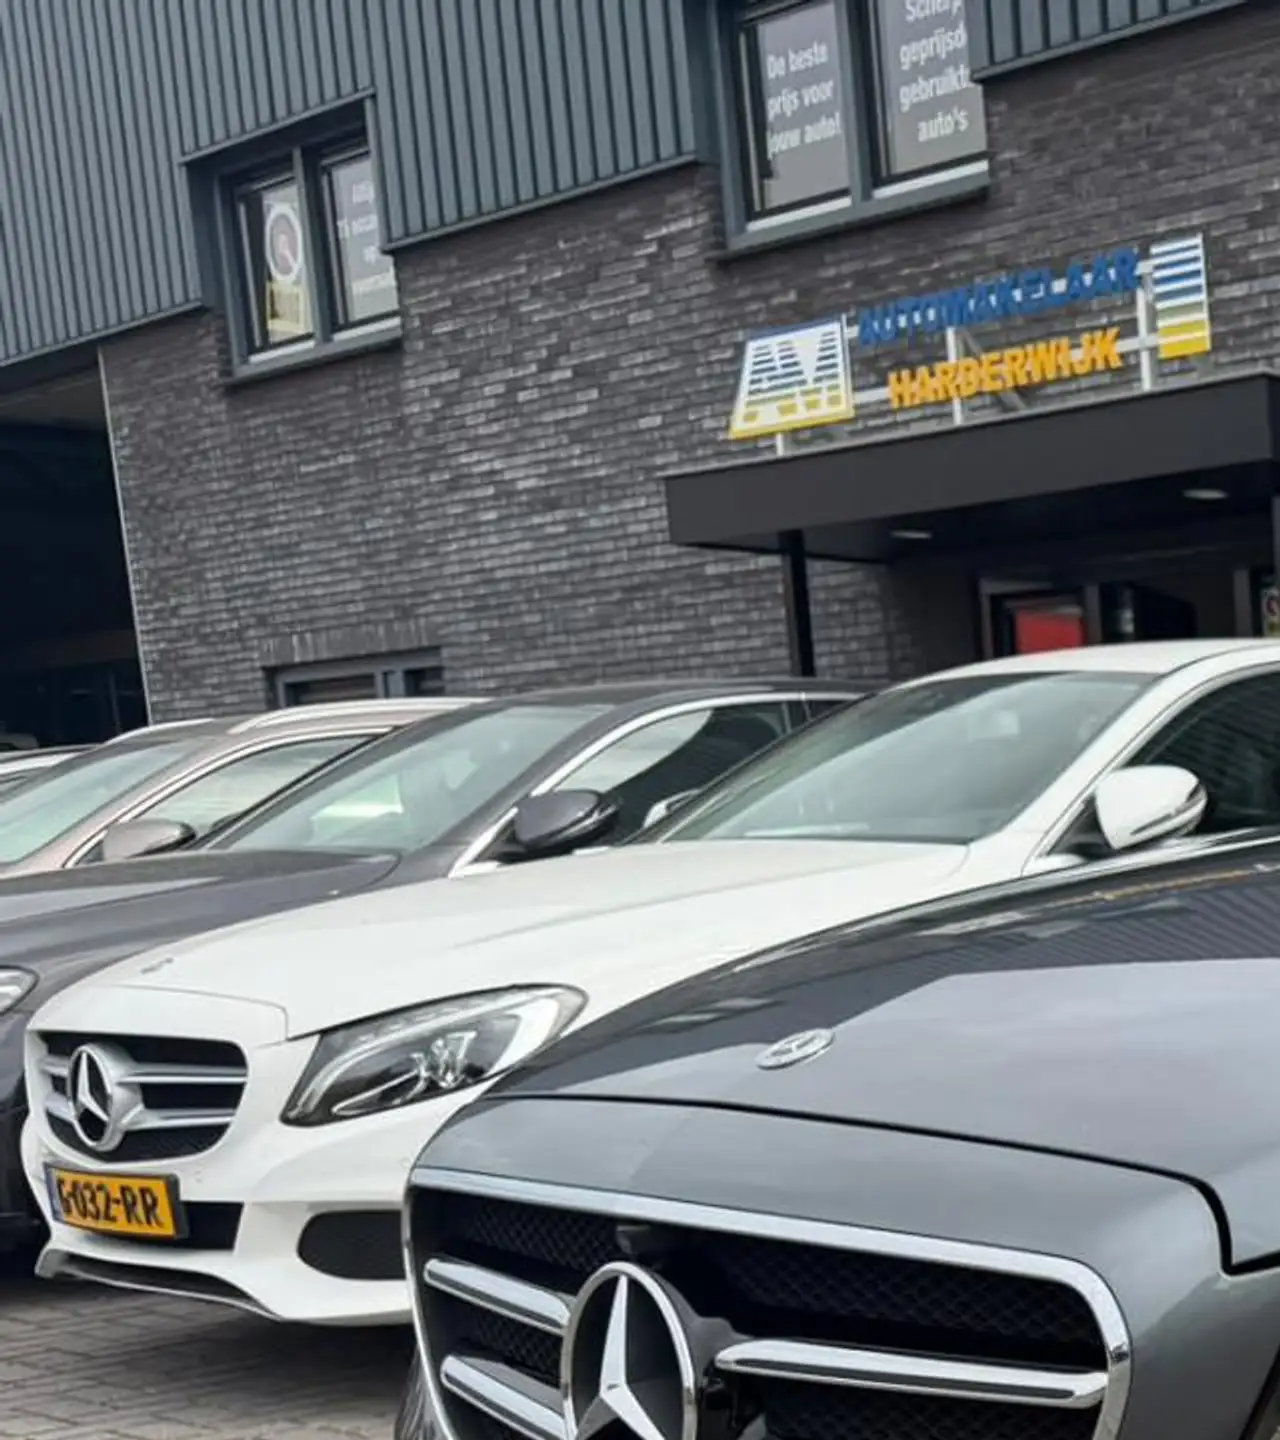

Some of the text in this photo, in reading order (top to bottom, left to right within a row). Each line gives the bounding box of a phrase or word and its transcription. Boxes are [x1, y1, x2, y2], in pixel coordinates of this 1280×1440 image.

[766, 40, 829, 80] De beste
[899, 21, 968, 71] geprijsd
[767, 80, 834, 122] prijs voor
[804, 112, 842, 144] auto!
[918, 106, 969, 142] auto's
[858, 246, 1140, 346] AUTOMAKELAAR
[887, 327, 1122, 409] HARDERWIJK
